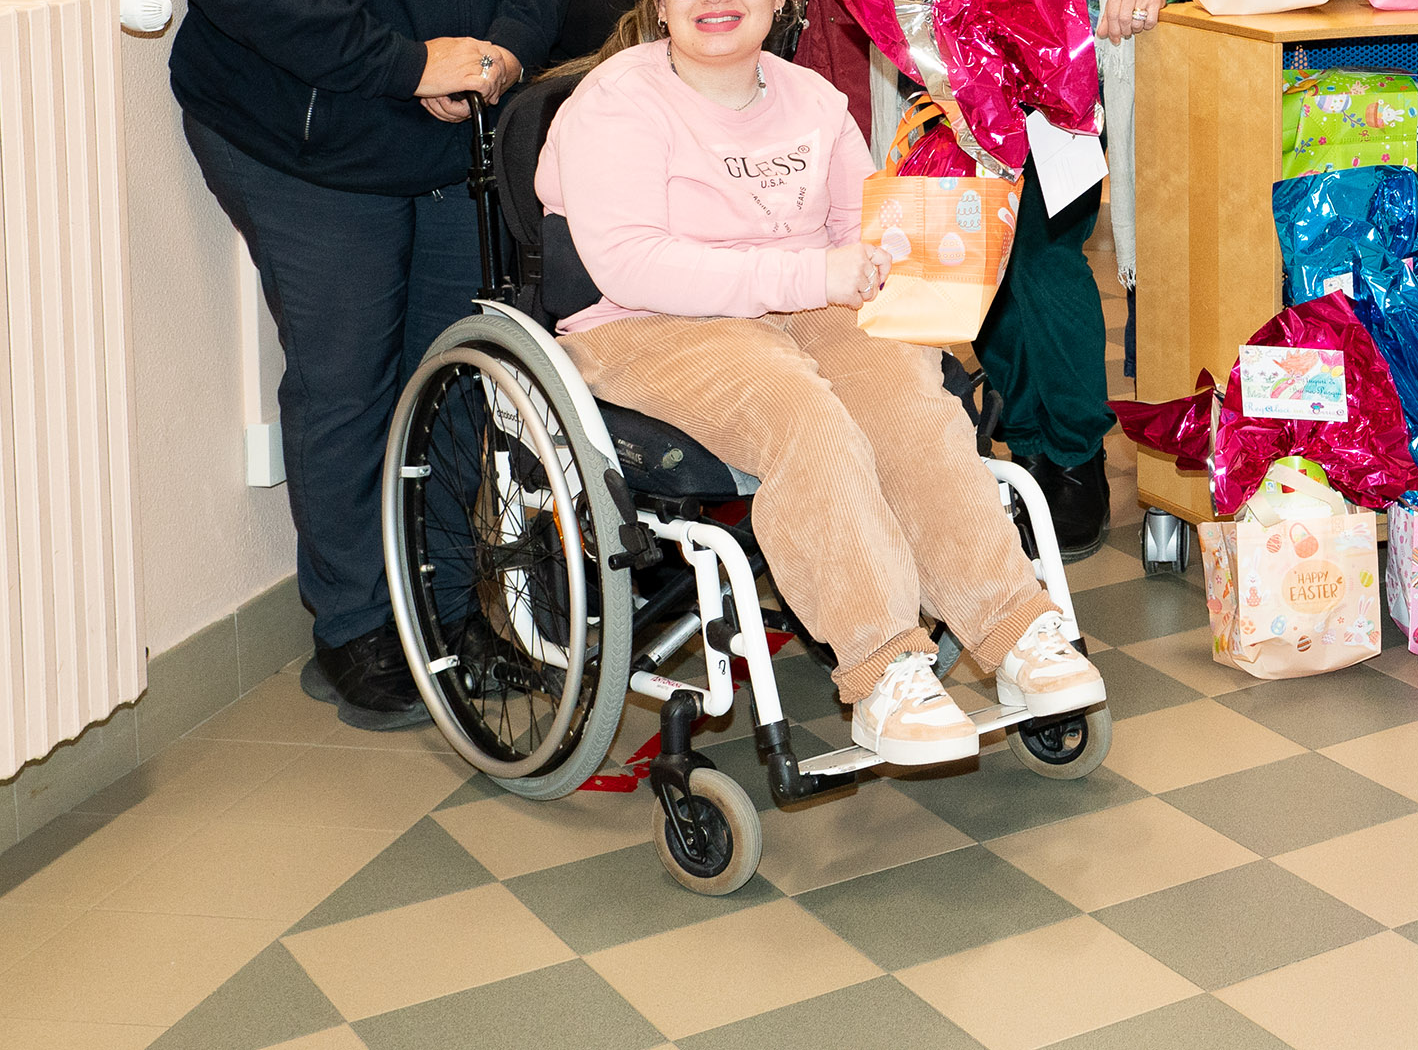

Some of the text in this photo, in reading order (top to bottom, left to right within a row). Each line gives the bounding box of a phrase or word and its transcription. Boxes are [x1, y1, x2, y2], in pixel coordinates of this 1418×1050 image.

[760, 178, 787, 189] U.S.A.
[796, 186, 807, 211] JEANS
[1297, 570, 1329, 584] HAPPY
[1289, 583, 1339, 602] EASTER
